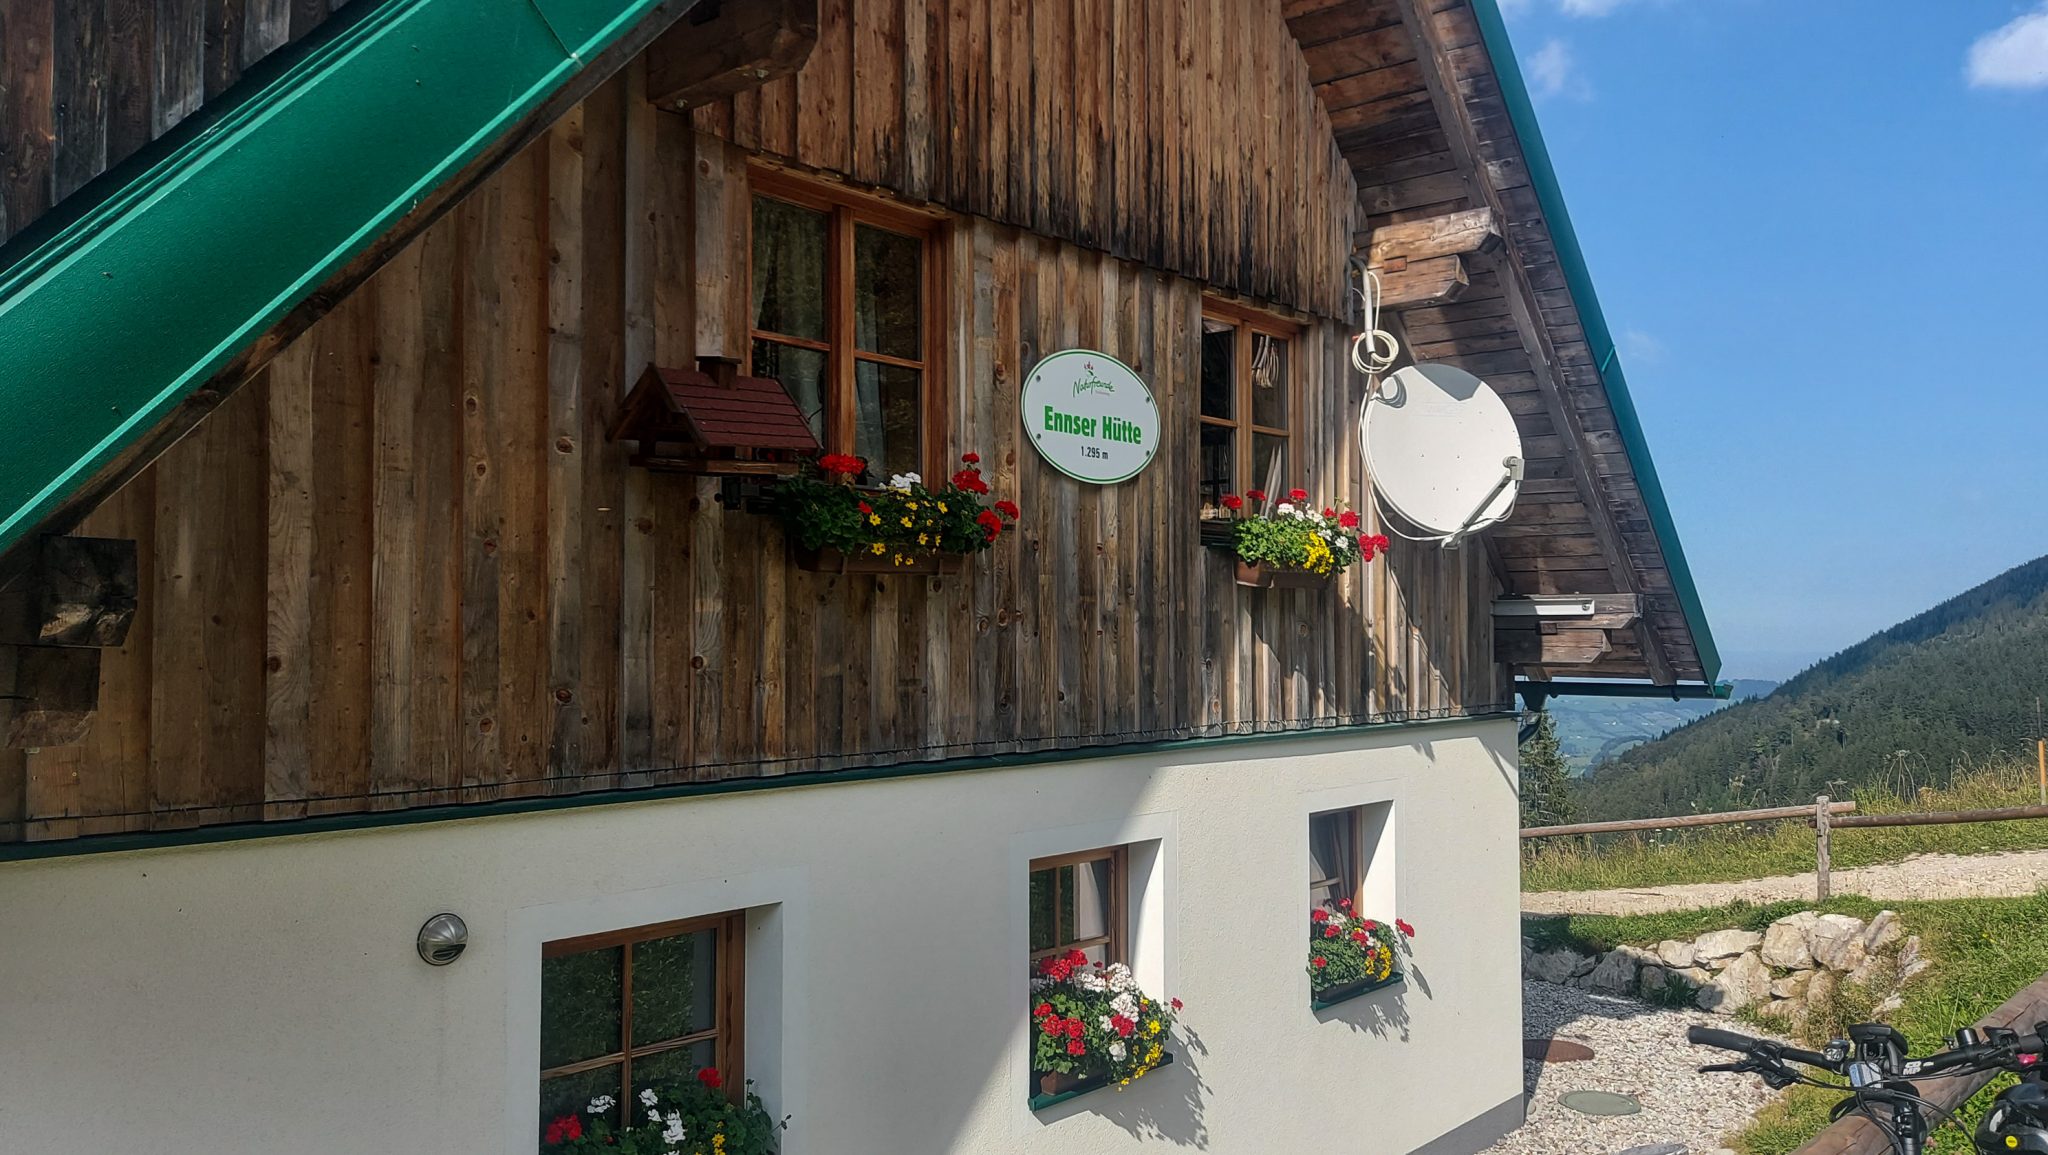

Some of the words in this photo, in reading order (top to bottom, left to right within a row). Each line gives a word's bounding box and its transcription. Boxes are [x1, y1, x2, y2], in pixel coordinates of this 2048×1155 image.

[1044, 405, 1097, 437] Ennser
[1102, 415, 1142, 444] Hütte
[1081, 446, 1100, 459] 1.295
[1102, 451, 1108, 459] m
